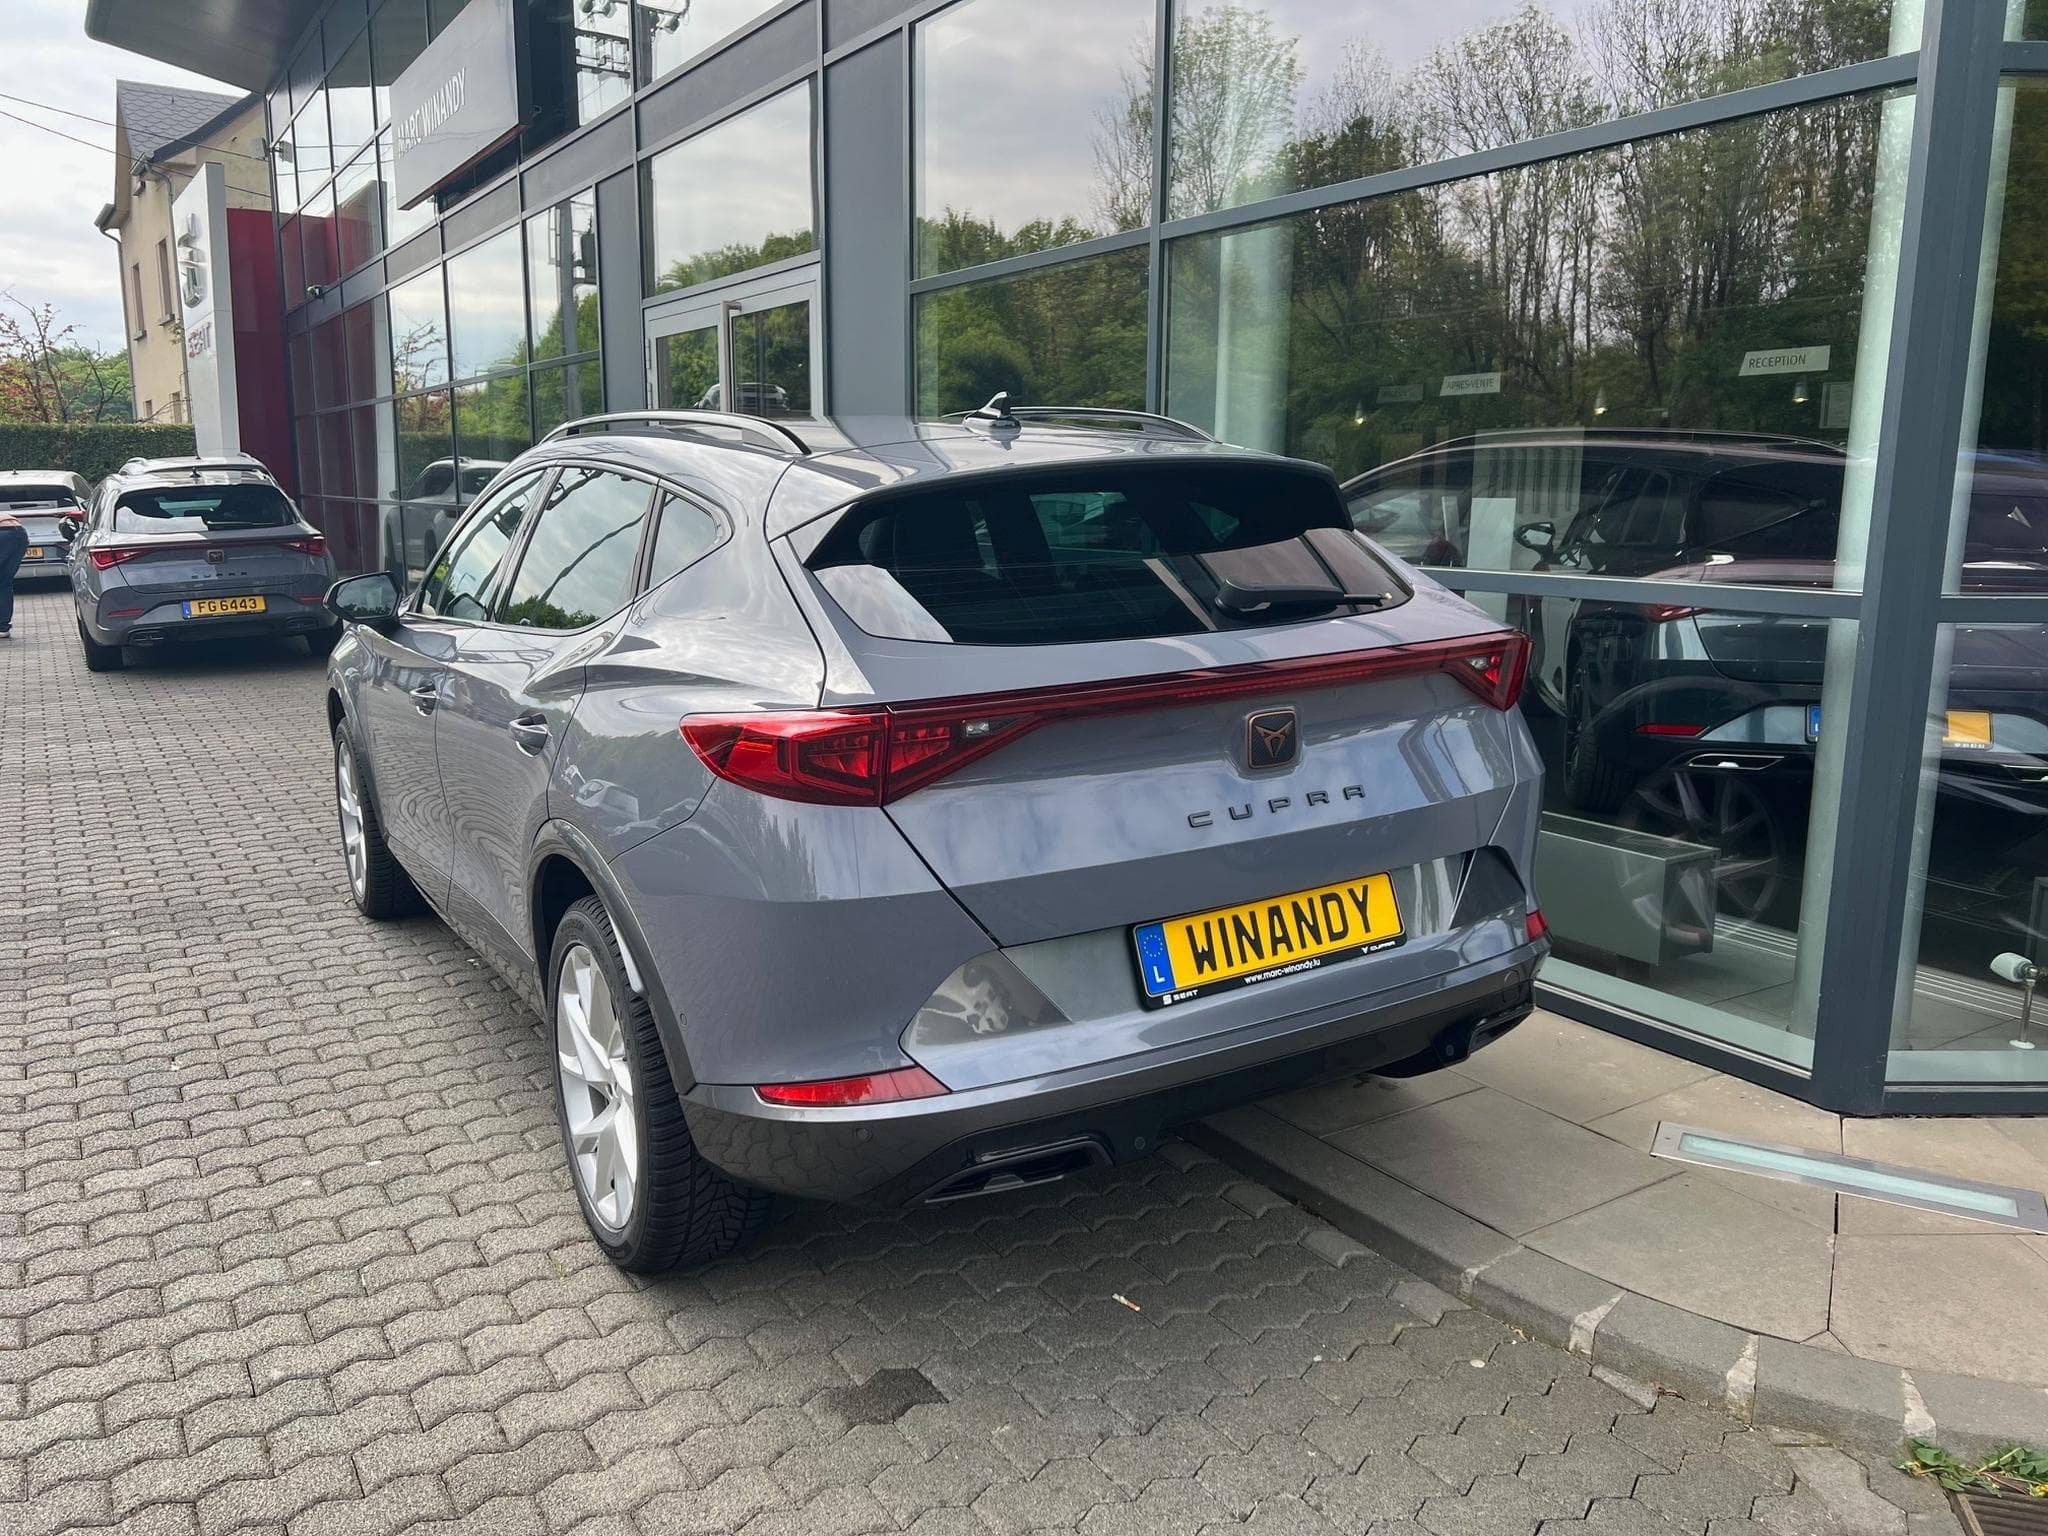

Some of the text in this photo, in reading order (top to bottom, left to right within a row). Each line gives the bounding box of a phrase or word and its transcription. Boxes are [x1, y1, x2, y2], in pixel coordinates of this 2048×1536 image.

[397, 67, 466, 160] MARC WINANDY
[1748, 355, 1806, 369] RECEPTION
[198, 601, 217, 613] FG
[220, 598, 257, 612] 6443
[1188, 785, 1366, 828] CUPRA
[1186, 885, 1372, 975] WINANDY
[1153, 966, 1165, 983] L
[1244, 958, 1321, 984] www.marc-winandy.lu
[1172, 989, 1199, 1001] SEAT
